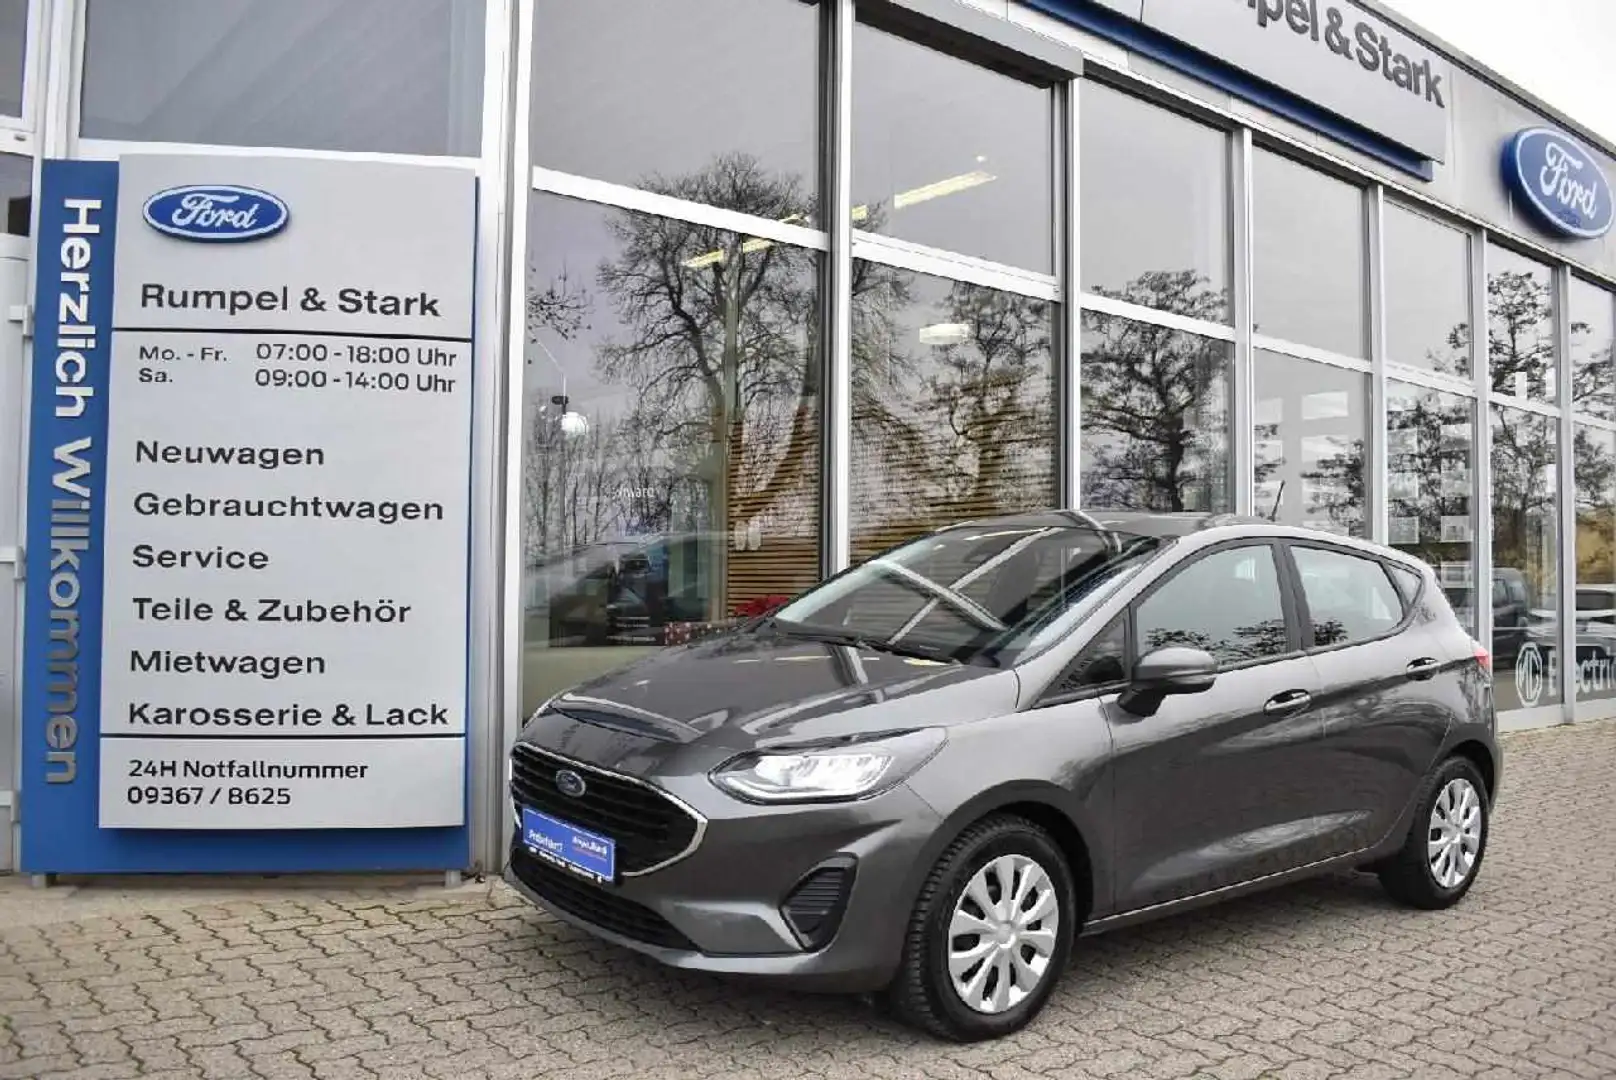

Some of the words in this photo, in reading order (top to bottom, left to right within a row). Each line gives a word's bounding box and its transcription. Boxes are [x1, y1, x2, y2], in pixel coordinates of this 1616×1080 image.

[1247, 0, 1319, 42] pel
[1324, 7, 1354, 60] &
[1354, 21, 1445, 109] Stark
[1540, 141, 1597, 220] Ford
[171, 193, 259, 229] Ford
[55, 198, 102, 418] Herzlich
[141, 283, 288, 316] Rumpel
[300, 287, 327, 312] &
[338, 288, 441, 317] Stark
[139, 345, 182, 361] Mo.
[201, 347, 227, 362] Fr.
[256, 343, 328, 362] 07:00
[347, 345, 410, 364] 18:00
[417, 347, 457, 366] Uhr
[139, 367, 173, 383] Sa.
[255, 368, 327, 388] 09:00
[345, 371, 410, 391] 14:00
[416, 373, 456, 393] Uhr
[136, 440, 325, 468] Neuwagen
[133, 491, 444, 525] Gebrauchtwagen
[132, 544, 269, 570] Service
[45, 436, 92, 784] Willkommen
[132, 597, 214, 622] Teile
[224, 598, 249, 622] &
[257, 598, 412, 623] Zubehör
[130, 649, 325, 680] Mietwagen
[129, 702, 322, 727] Karosserie
[331, 703, 357, 727] &
[366, 703, 448, 727] Lack
[128, 759, 177, 778] 24H
[183, 759, 369, 779] Notfallnummer
[127, 785, 204, 805] 09367
[209, 787, 222, 805] /
[228, 786, 291, 805] 8625
